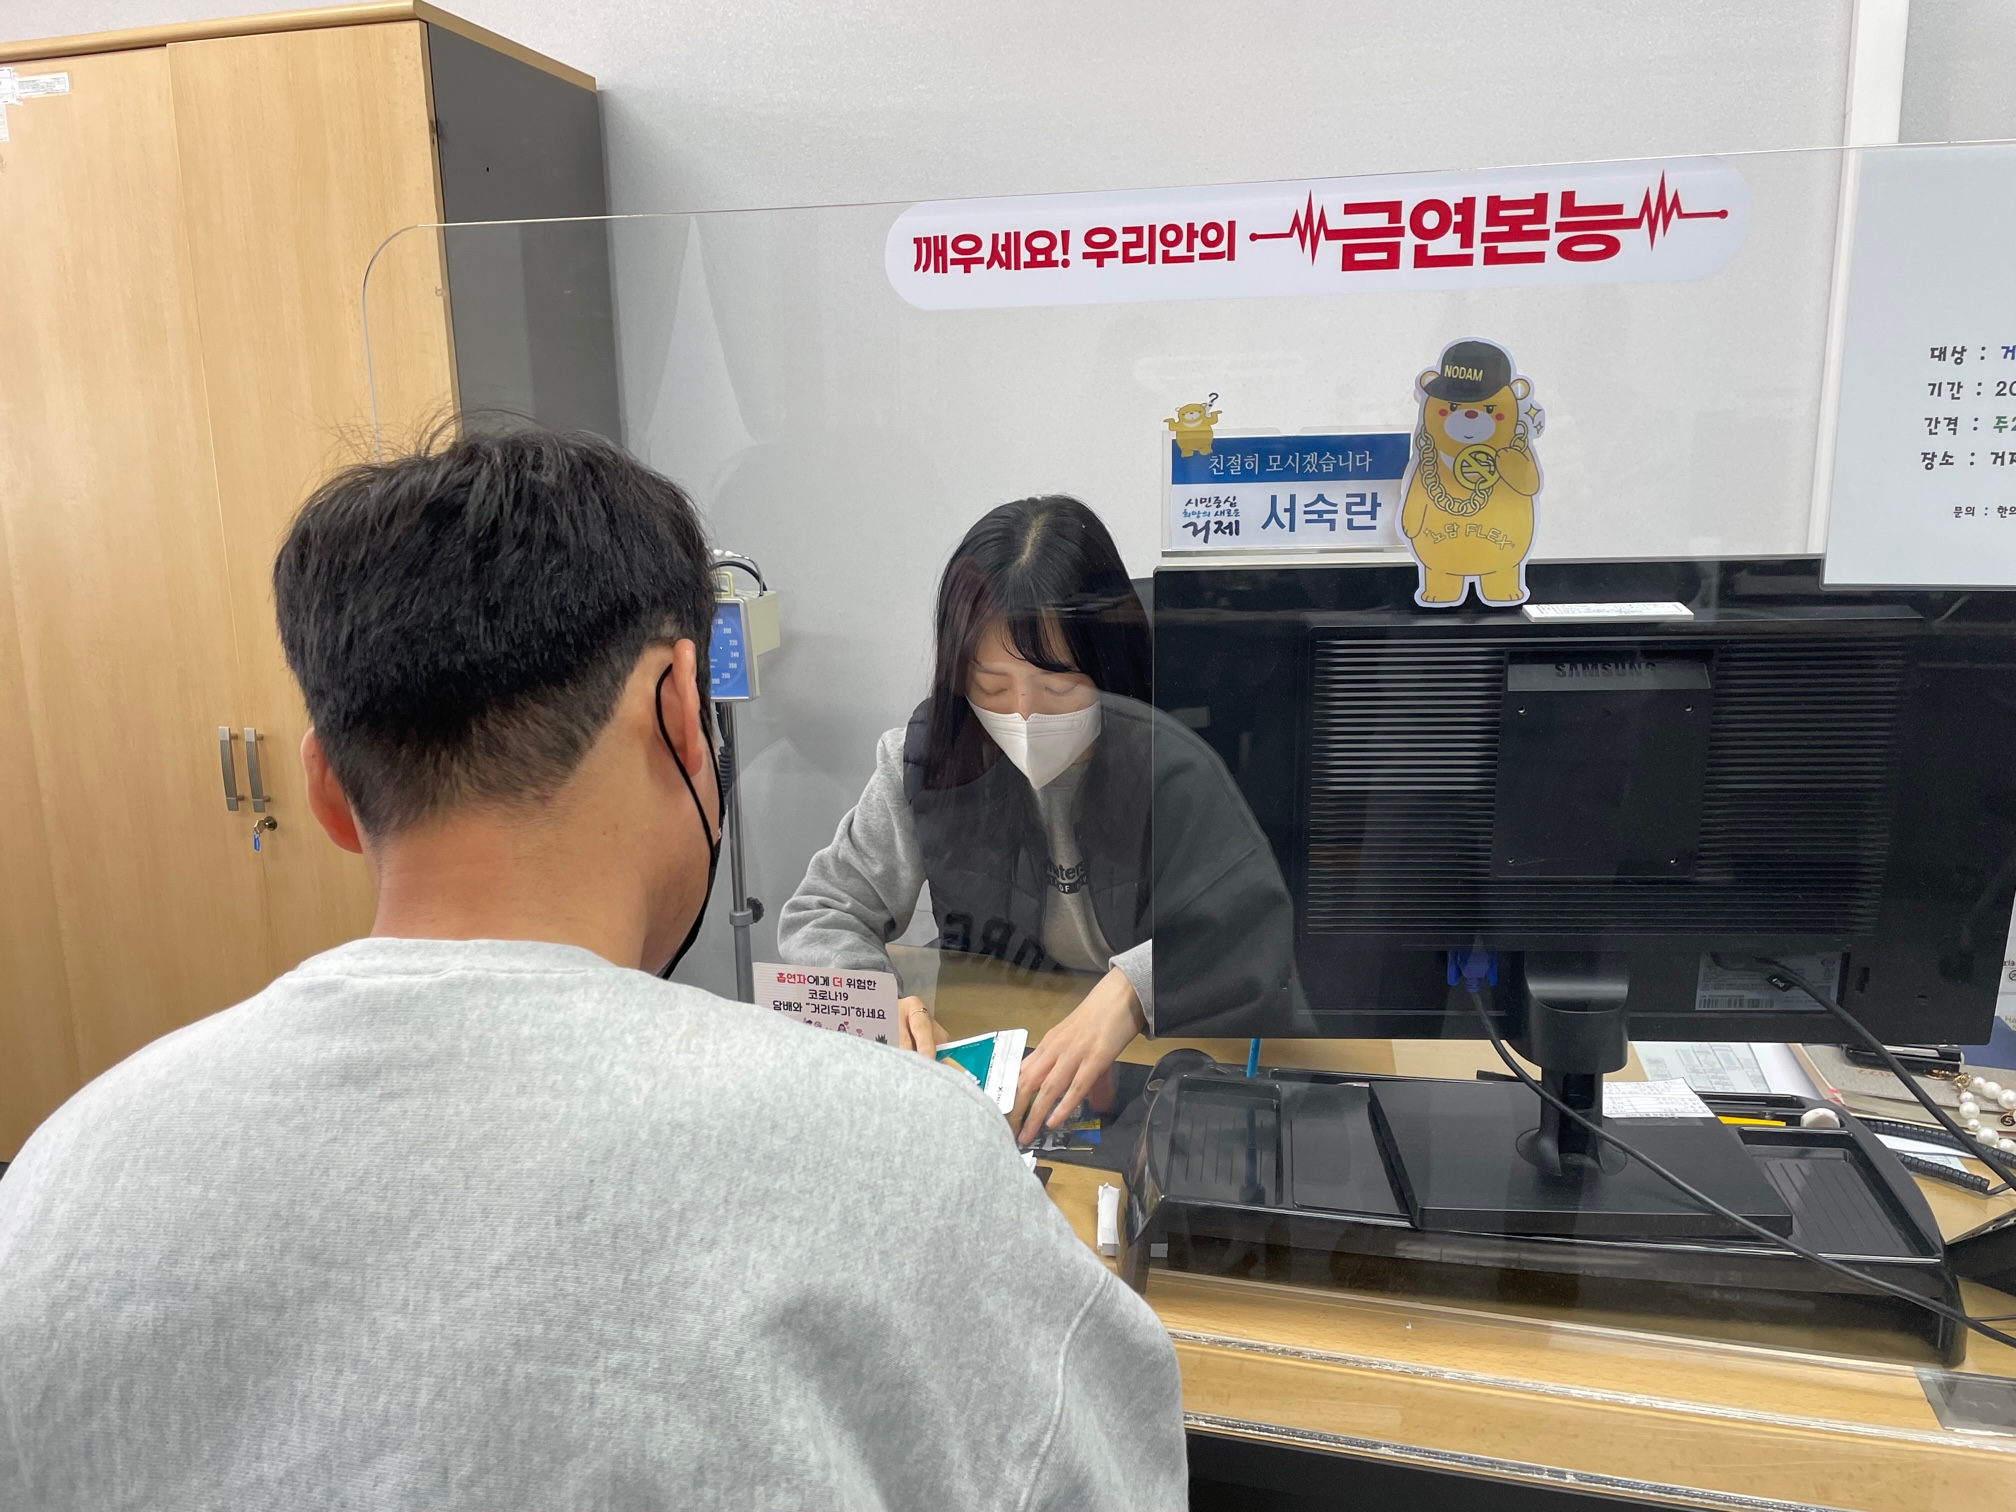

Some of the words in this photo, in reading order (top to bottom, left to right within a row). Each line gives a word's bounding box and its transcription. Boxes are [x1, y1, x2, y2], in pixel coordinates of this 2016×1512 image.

[913, 229, 1071, 274] 깨우세요!
[1082, 220, 1237, 268] 우리안의
[1341, 190, 1625, 272] 금연본능
[1930, 346, 1967, 365] 대상
[1443, 364, 1484, 382] NODAM
[1928, 381, 1963, 400] 기간
[1924, 416, 1959, 435] 간격
[1208, 453, 1260, 475] 친절히
[1265, 450, 1373, 474] 모시겠습니다
[1921, 451, 1954, 470] 장소
[1185, 495, 1237, 509] 시민중심
[1261, 491, 1382, 533] 서숙란
[1953, 506, 1976, 518] 문의
[1182, 519, 1240, 544] 거제
[1430, 522, 1459, 545] 노담
[1465, 523, 1512, 550] FLEX
[777, 972, 830, 987] 흡연자에게
[832, 977, 843, 987] 더
[846, 978, 877, 990] 위험한
[808, 989, 849, 1001] 코로나19
[773, 1000, 802, 1012] 담배와
